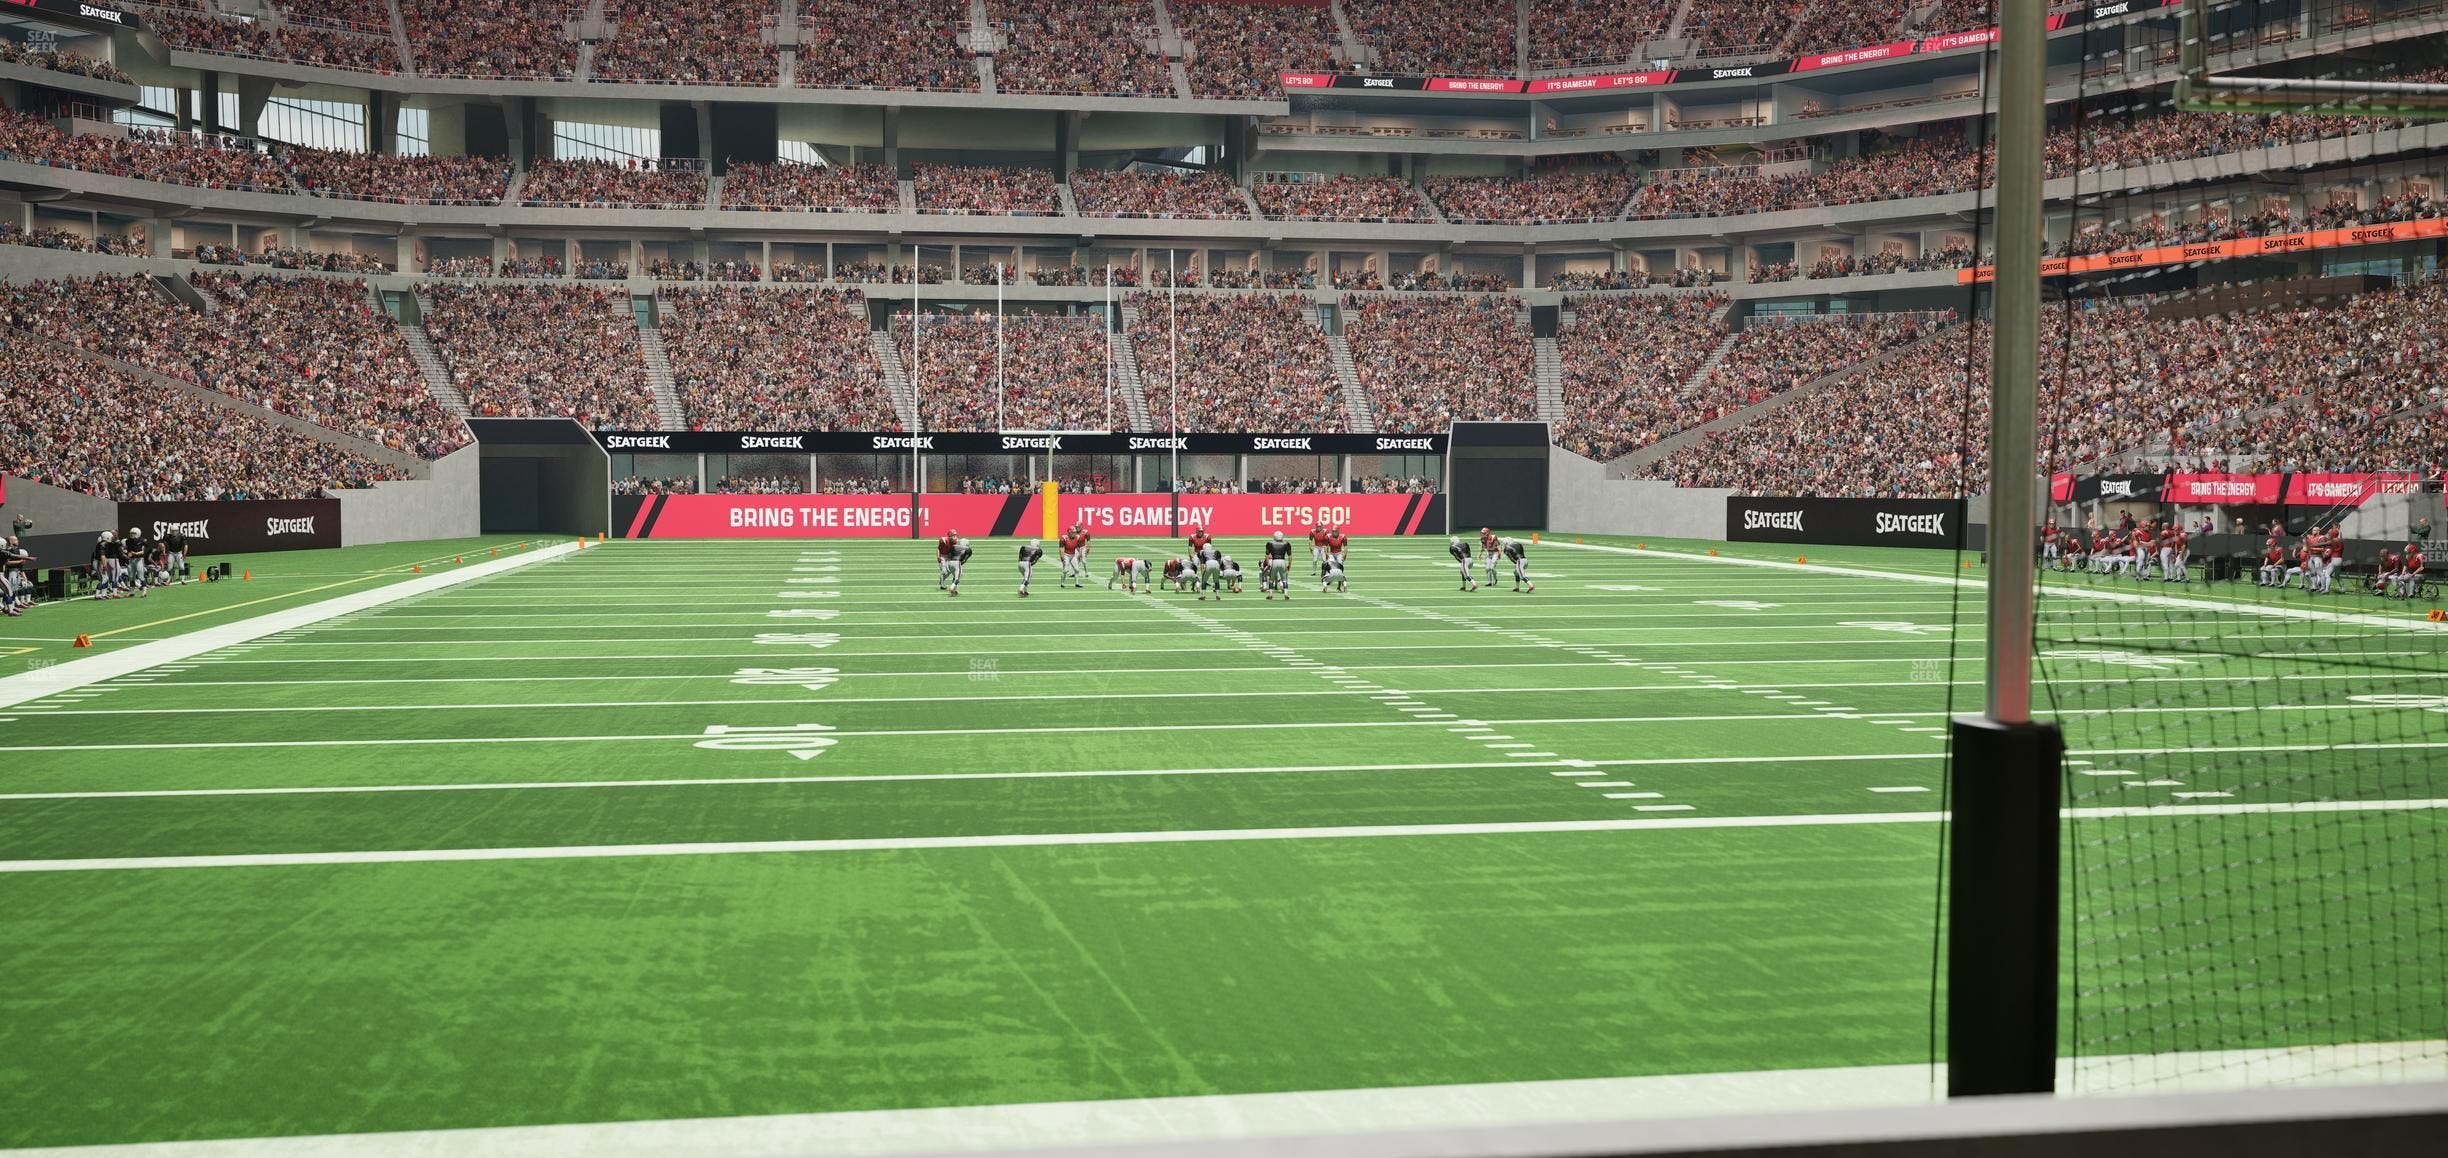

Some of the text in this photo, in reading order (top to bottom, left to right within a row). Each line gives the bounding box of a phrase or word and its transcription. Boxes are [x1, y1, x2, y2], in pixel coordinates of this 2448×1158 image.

[80, 3, 122, 24] SEATGEEK
[2095, 2, 2129, 18] SEATGEEK
[1942, 37, 1957, 47] IT'S
[1820, 48, 1890, 66] BRING THE ENERGY!
[1713, 67, 1752, 79] SEATGEEK
[1286, 77, 1313, 85] LET'S GO!
[1363, 78, 1394, 88] SEATGEEK
[1547, 76, 1648, 90] IT'S GAMEDAY LET'S GO!
[2352, 228, 2395, 241] SEATGEEK
[2264, 237, 2305, 250] SEATGEEK
[2184, 246, 2221, 258] SEATGEEK
[607, 435, 670, 448] SEATGEEK
[741, 435, 804, 449] SEATGEEK
[1129, 437, 1188, 450] SEATGEEK
[1253, 437, 1312, 450] SEATGEEK
[1376, 437, 1433, 450] SEATGEEK
[730, 507, 794, 527] BRING
[799, 507, 839, 527] THE
[1078, 506, 1351, 526] IT'S GAMEDAY LET'S GO!
[1744, 509, 1804, 532] SEATGEEK
[267, 516, 315, 536] SEATGEEK
[1876, 512, 1945, 536] SEATGEEK
[692, 723, 840, 750] 10
